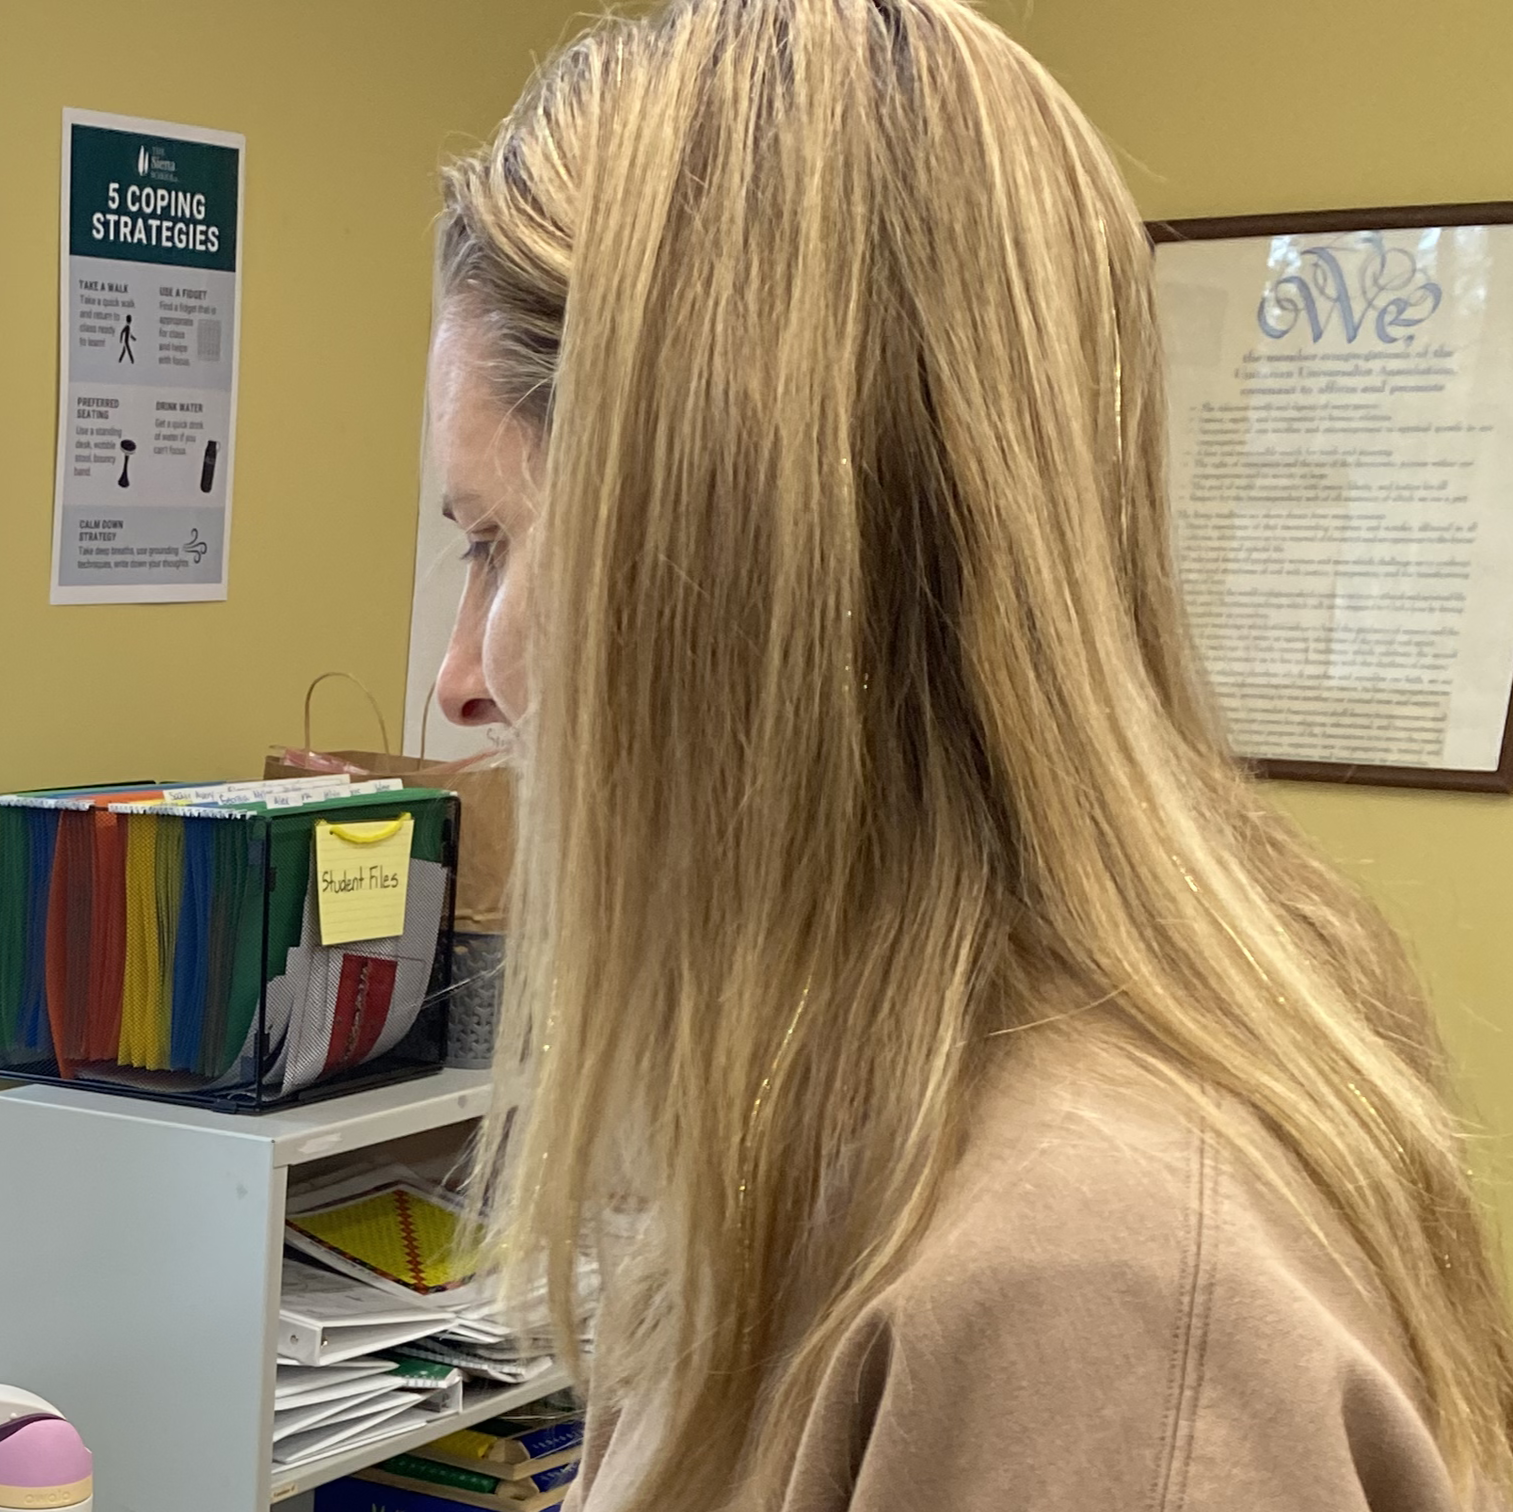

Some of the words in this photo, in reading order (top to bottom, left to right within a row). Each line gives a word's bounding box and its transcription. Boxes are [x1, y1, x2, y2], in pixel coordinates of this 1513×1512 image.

[108, 183, 120, 210] 5
[126, 184, 206, 220] COPING
[92, 213, 219, 252] STRATEGIES
[79, 280, 98, 292] TAKE
[100, 283, 106, 292] A
[107, 283, 129, 293] WALK
[159, 287, 174, 297] USE
[175, 289, 181, 298] A
[182, 289, 208, 300] FIDGET
[77, 397, 120, 409] PREFERRED
[156, 401, 178, 412] DRINK
[179, 402, 204, 414] WATER
[76, 409, 109, 420] SEATING
[79, 519, 100, 530] CALM
[102, 520, 124, 530] DOWN
[79, 532, 117, 542] STRATEGY
[321, 865, 366, 894] Student
[368, 866, 400, 892] Files
